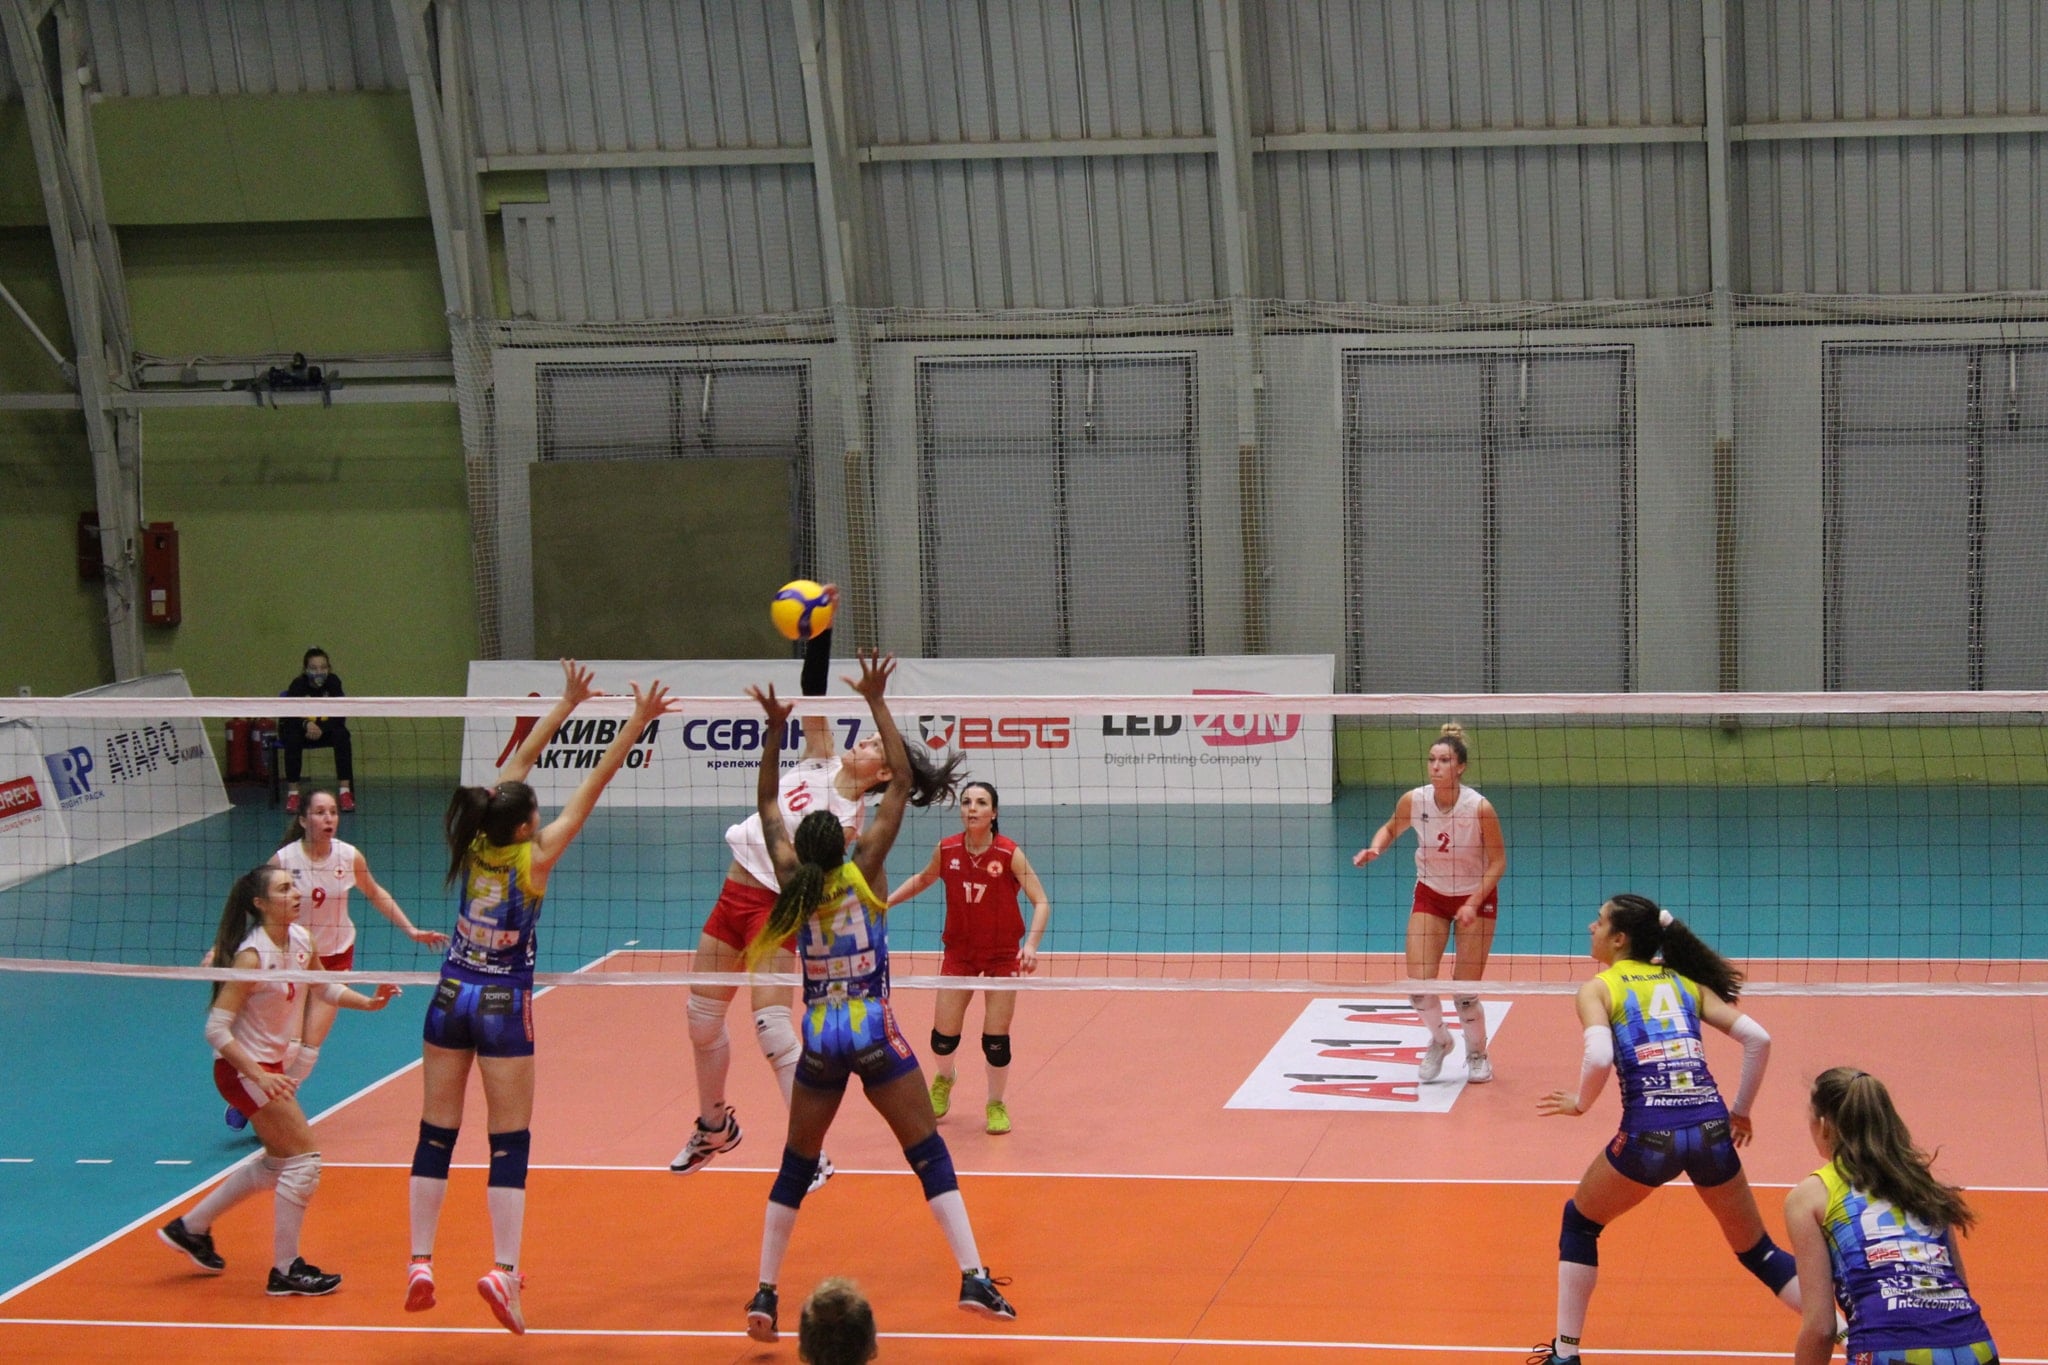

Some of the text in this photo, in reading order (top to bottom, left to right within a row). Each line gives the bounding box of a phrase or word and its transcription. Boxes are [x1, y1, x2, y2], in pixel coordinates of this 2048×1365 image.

[959, 717, 1070, 749] BSG
[1104, 753, 1262, 767] Digital Printing Company
[784, 781, 812, 812] 10
[1437, 832, 1450, 853] 2
[311, 887, 326, 909] 9
[468, 876, 502, 926] 2
[962, 881, 987, 903] 17
[806, 894, 870, 956] 14
[1650, 983, 1690, 1034] 4
[1887, 1297, 1972, 1312] Intercomplex
